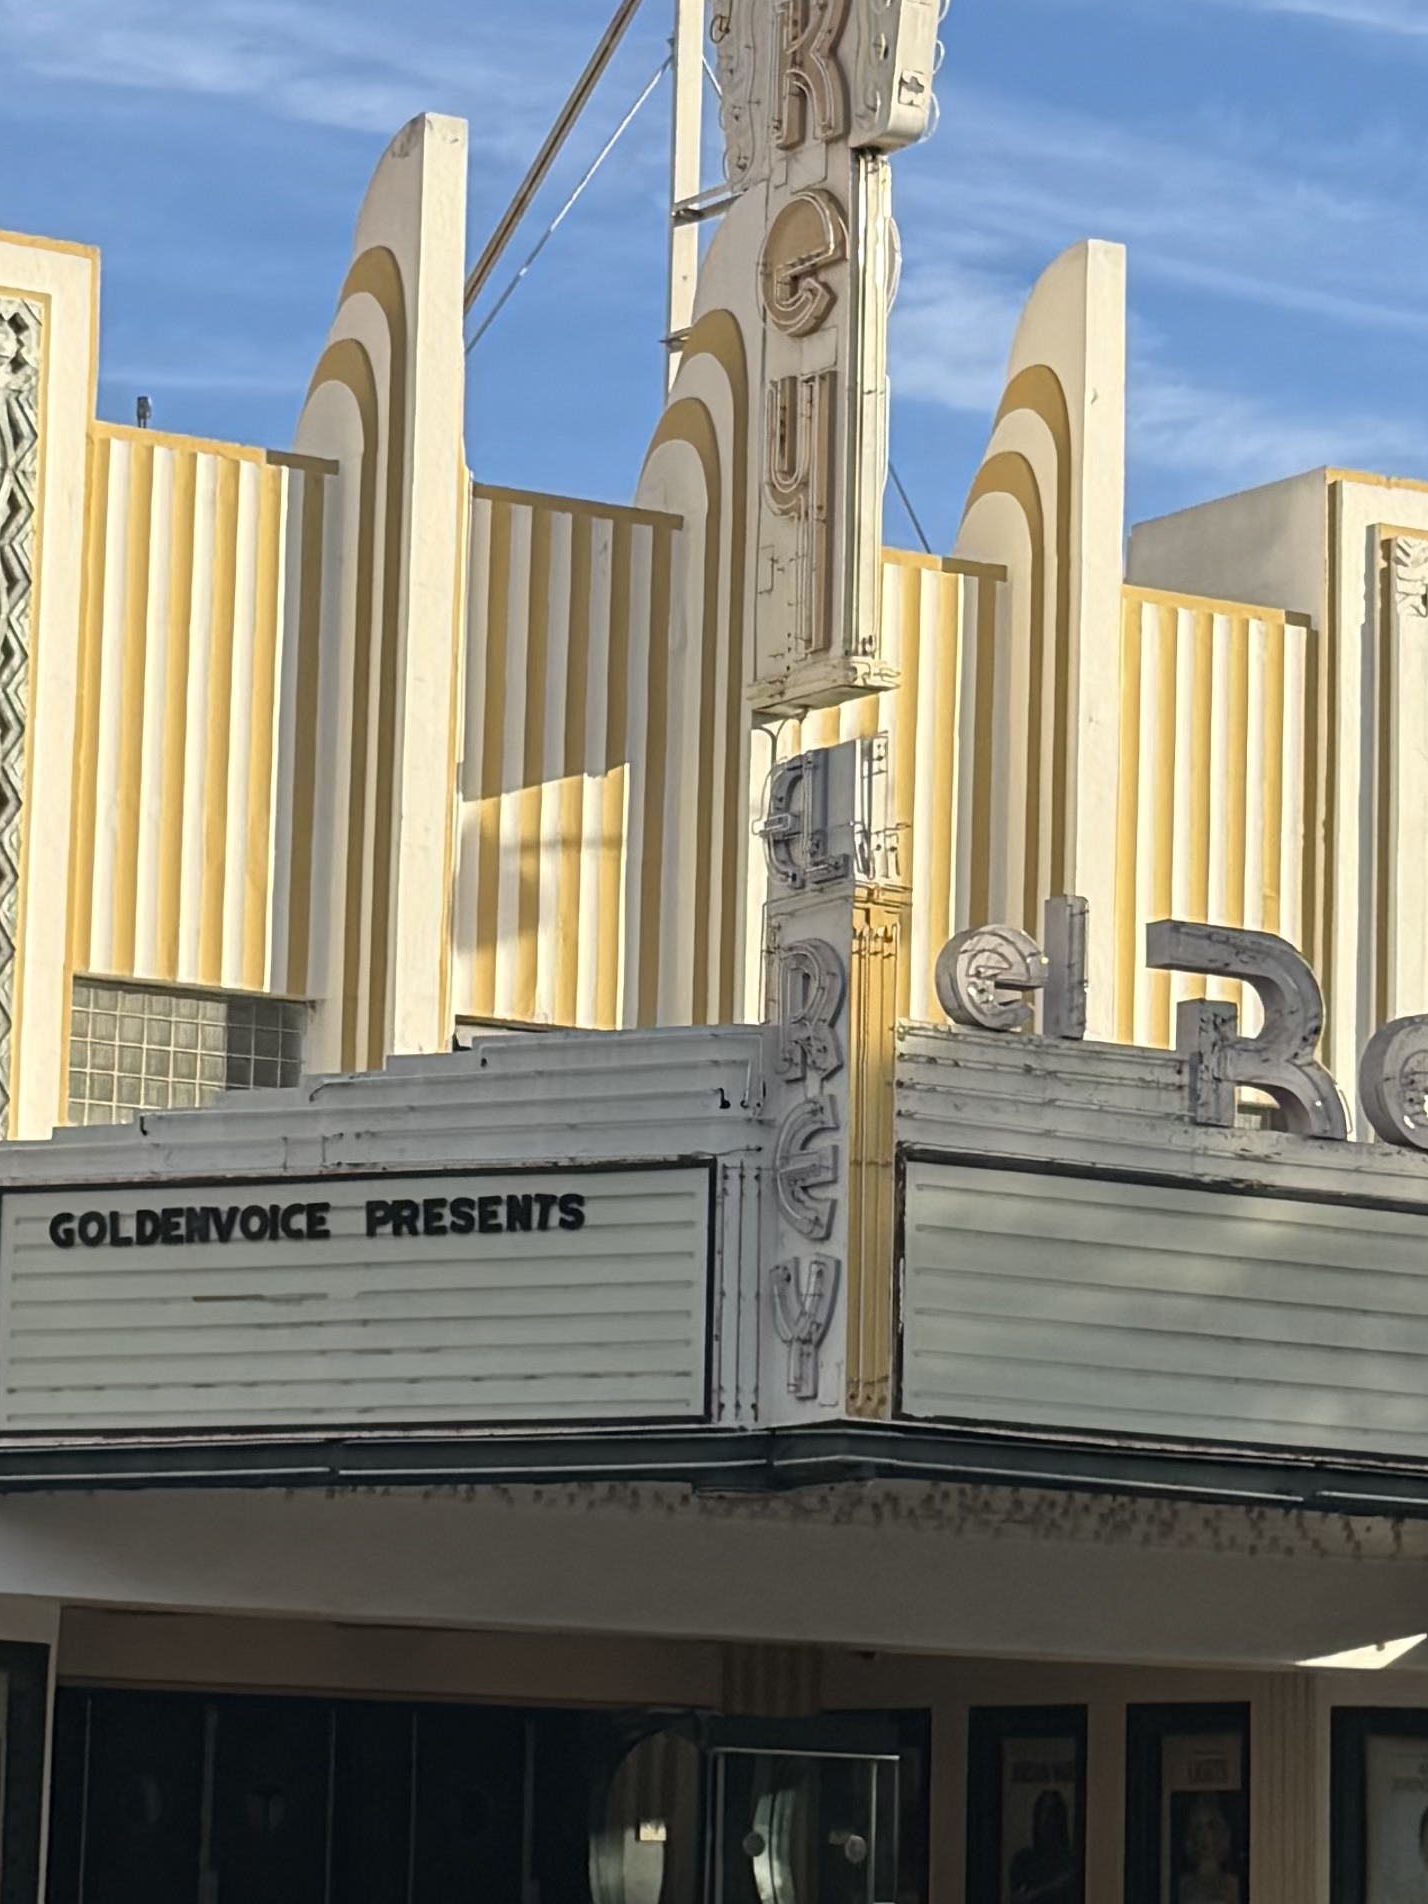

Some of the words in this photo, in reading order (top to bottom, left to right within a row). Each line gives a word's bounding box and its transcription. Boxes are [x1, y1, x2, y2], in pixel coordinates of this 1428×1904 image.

[935, 894, 1089, 1040] el
[49, 1202, 331, 1249] GOLDENVOICE
[365, 1192, 586, 1240] PRESENTS
